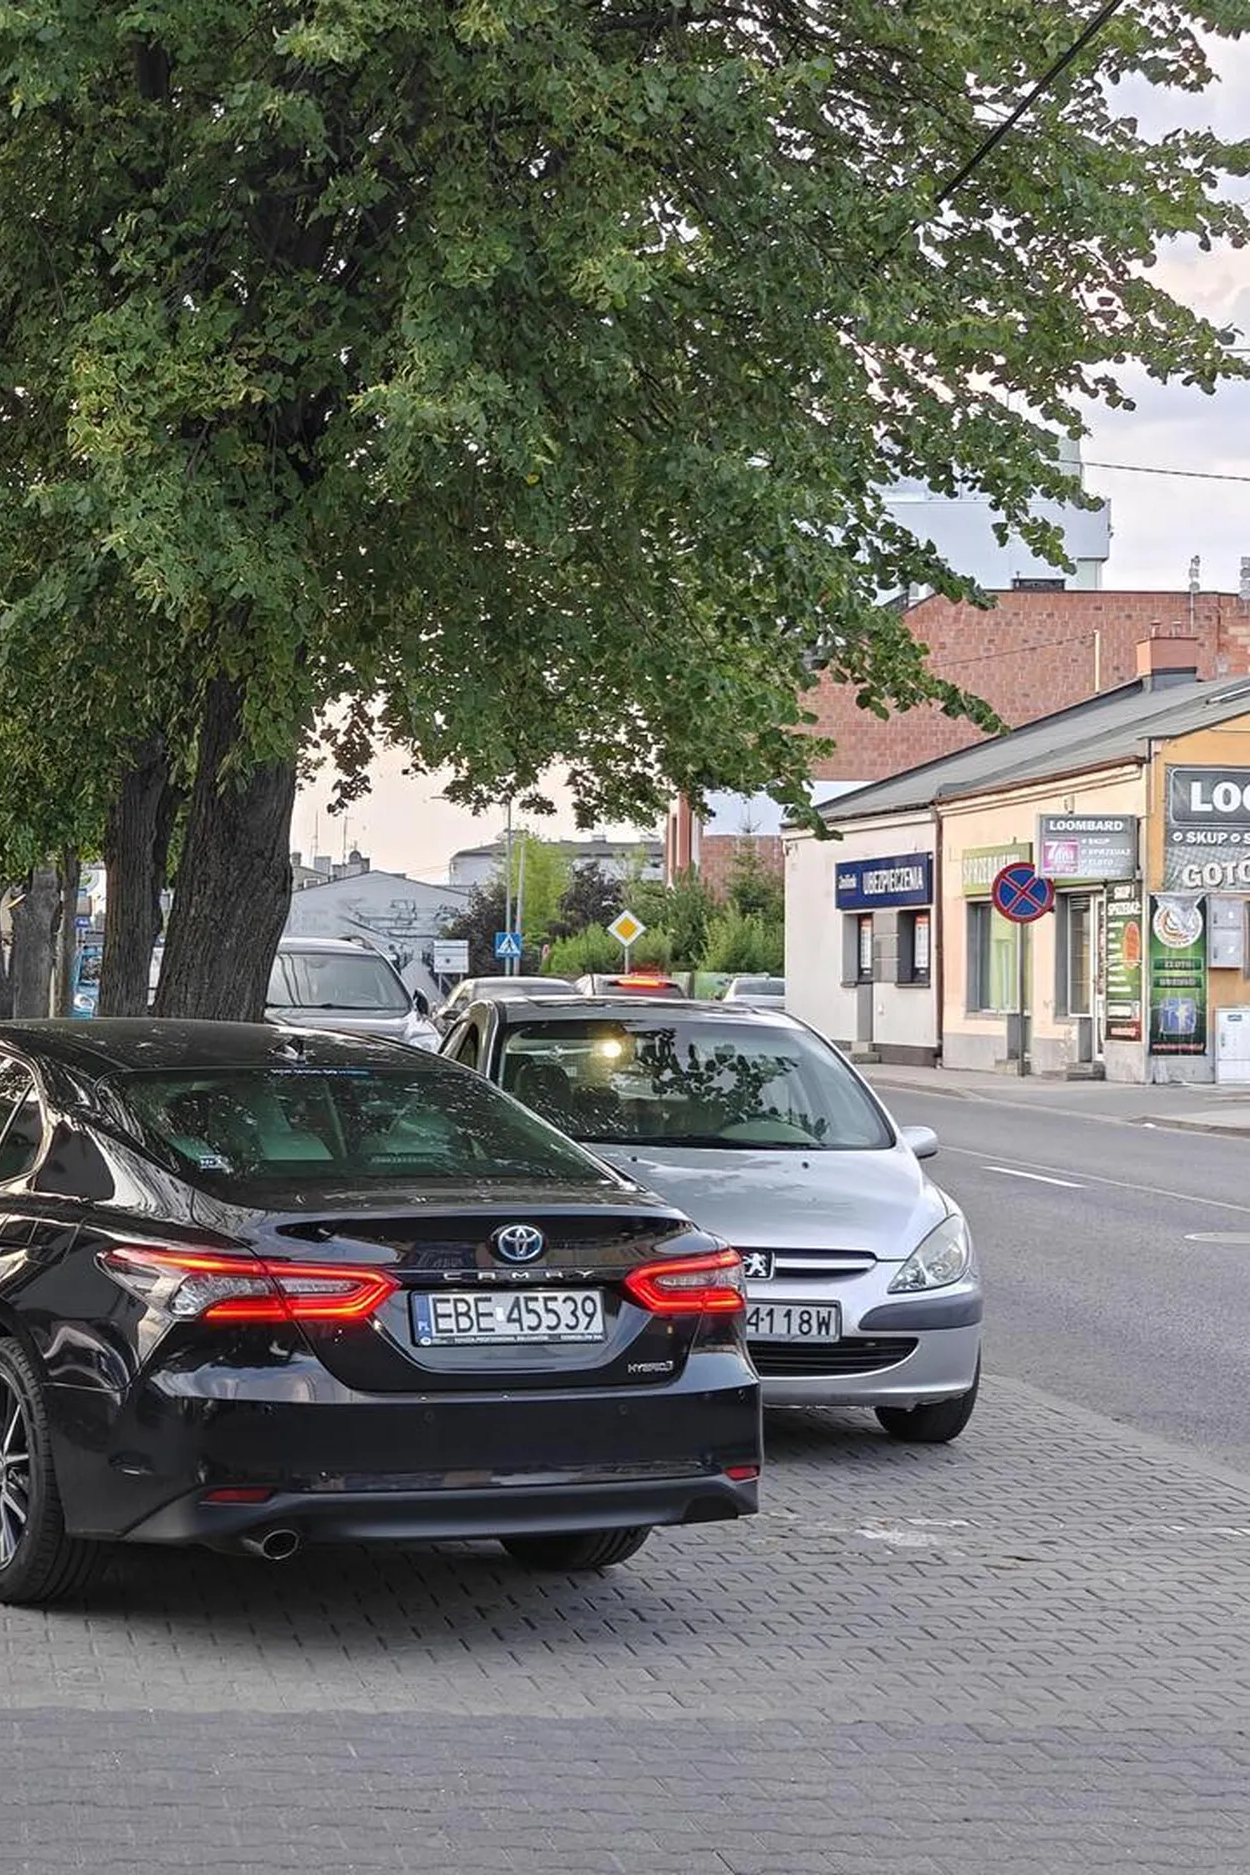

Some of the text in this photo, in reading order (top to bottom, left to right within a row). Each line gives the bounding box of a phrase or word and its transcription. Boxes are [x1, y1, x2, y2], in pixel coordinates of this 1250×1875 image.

[1190, 780, 1250, 813] LO
[1049, 820, 1124, 832] LOOMBARD
[1186, 831, 1228, 845] SKUP
[862, 865, 924, 895] UBEZPIECZENIA
[443, 1269, 595, 1281] CAMRY
[431, 1295, 598, 1334] EBE 45539
